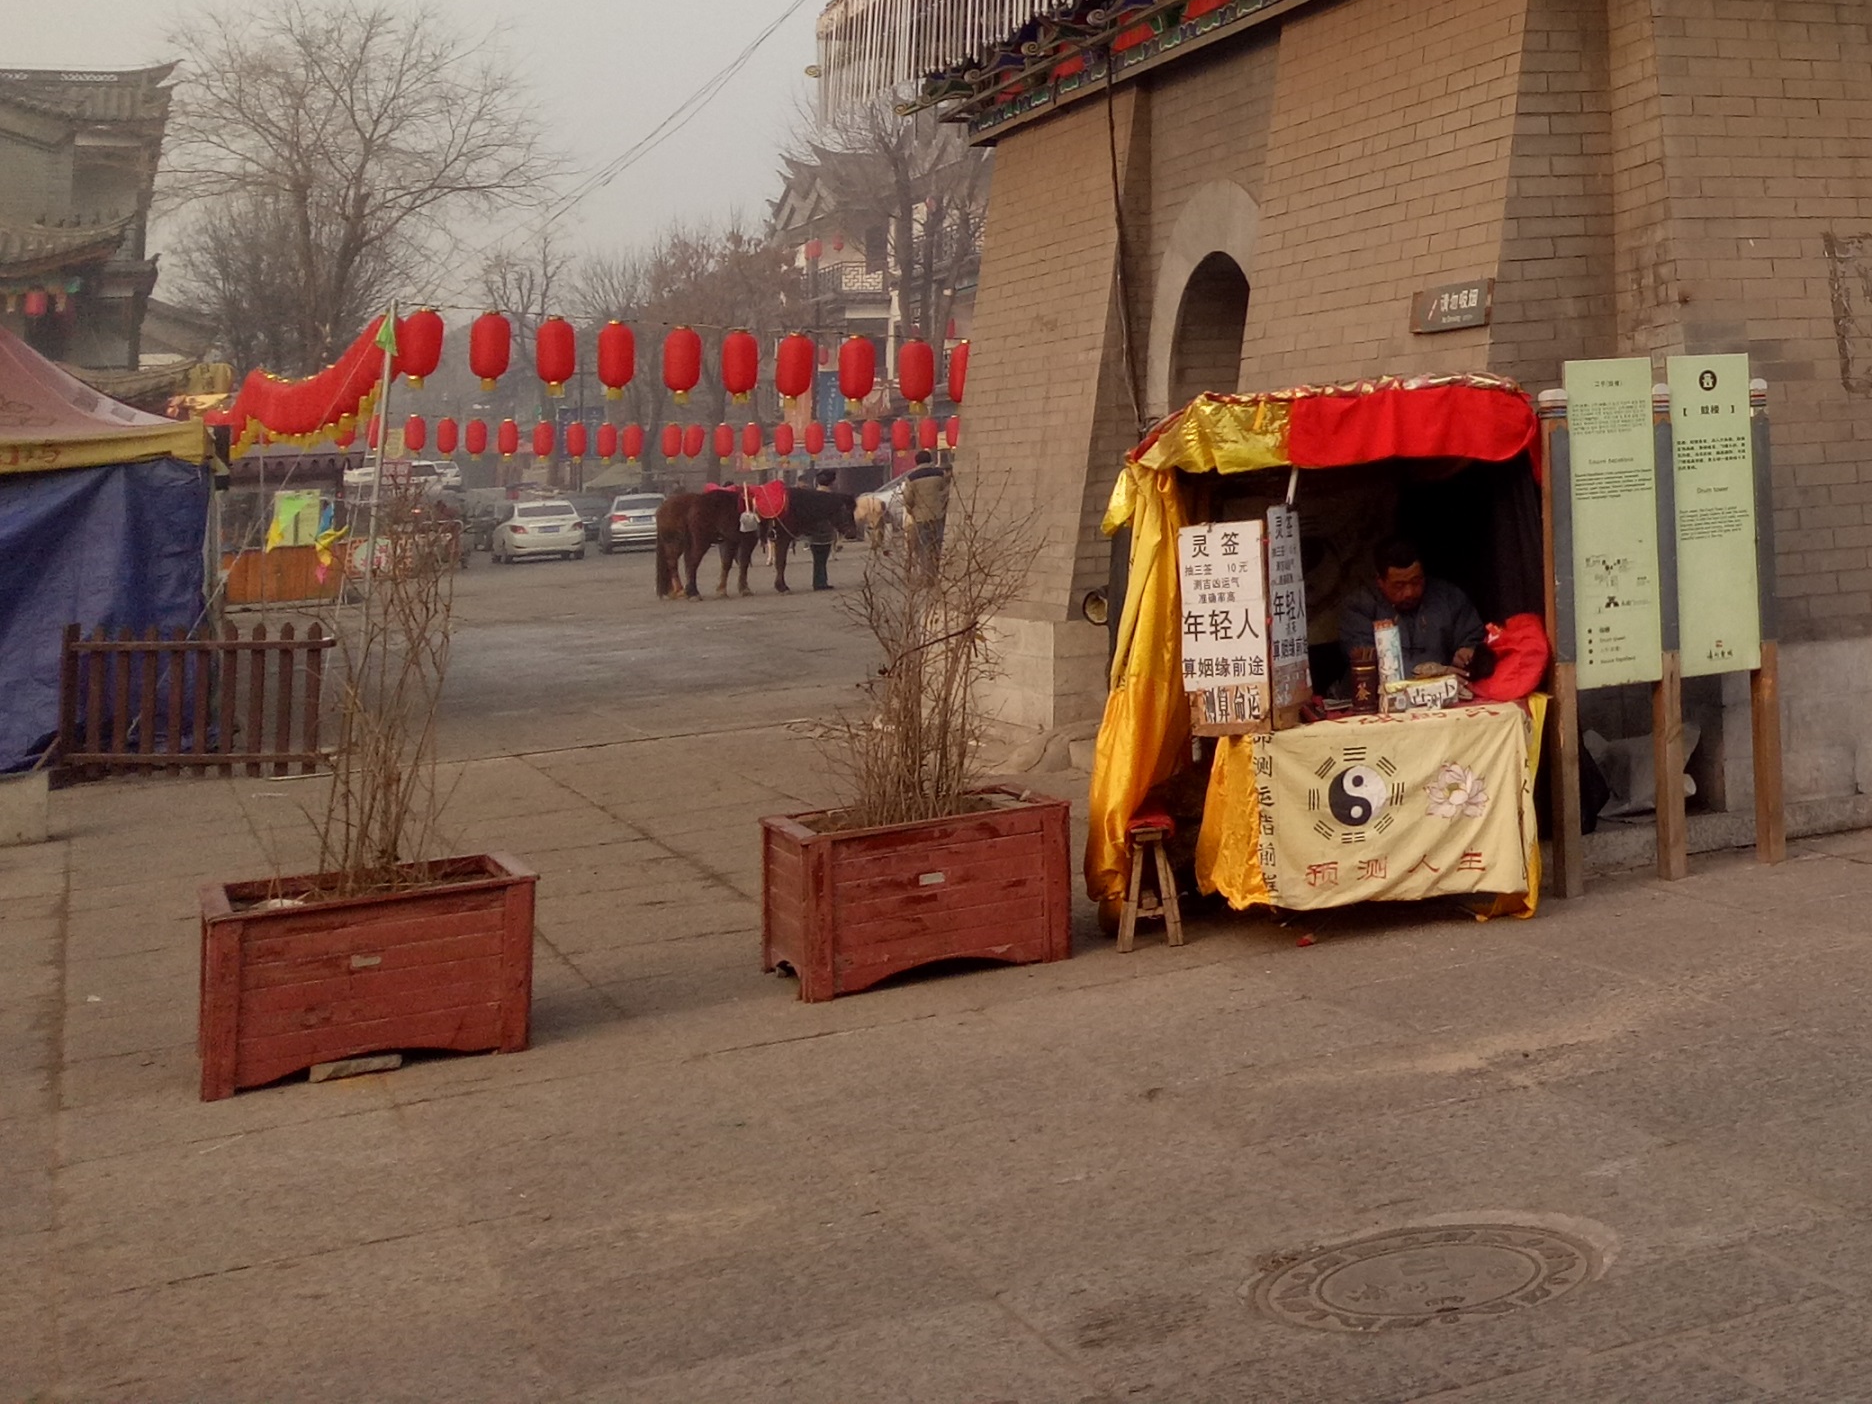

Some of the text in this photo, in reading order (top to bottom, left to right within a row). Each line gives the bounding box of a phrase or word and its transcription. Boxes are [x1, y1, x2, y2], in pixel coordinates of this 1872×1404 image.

[1191, 531, 1240, 558] 灵签
[1184, 564, 1213, 577] 抽三签
[1193, 577, 1240, 590] 测吉凶运气
[1198, 591, 1236, 604] 准确率高
[1273, 589, 1305, 623] 年轻人
[1183, 608, 1260, 643] 年轻人
[1182, 655, 1265, 679] 算姻缘前途
[1305, 847, 1487, 888] 预测人生
